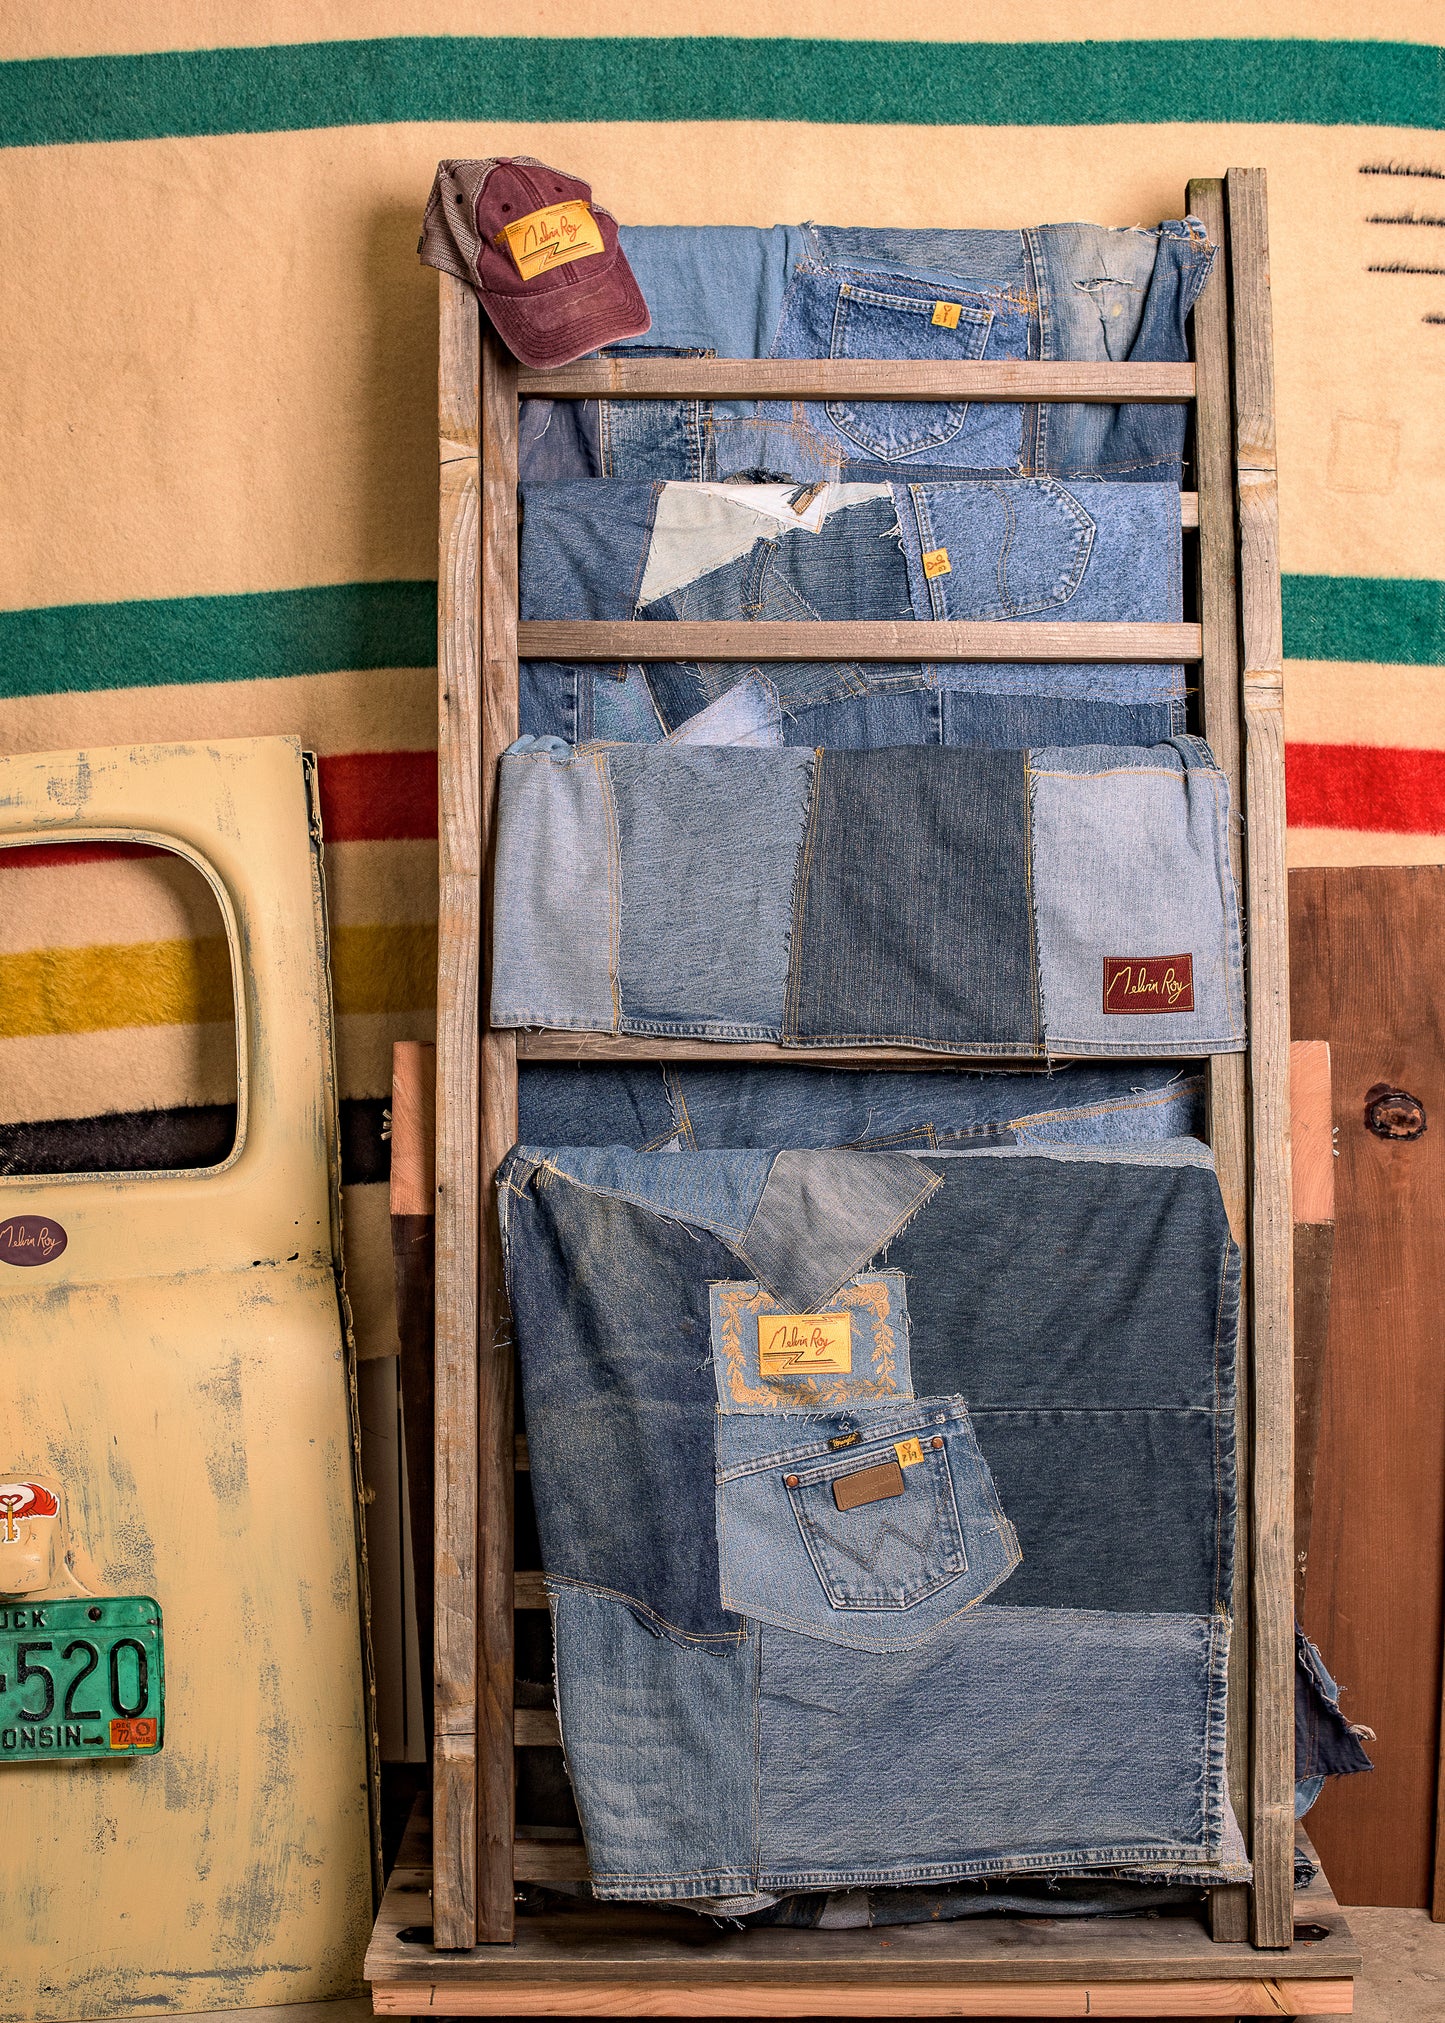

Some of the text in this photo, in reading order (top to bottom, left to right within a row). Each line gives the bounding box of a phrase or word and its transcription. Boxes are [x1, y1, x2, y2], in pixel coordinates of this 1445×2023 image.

[523, 215, 582, 252] Melvin Roy
[1106, 966, 1192, 1004] Melvin Roy
[37, 1227, 63, 1256] Roy
[769, 1325, 836, 1357] Melvin Roy
[2, 1724, 82, 1749] ONSIN
[117, 1729, 130, 1743] 72
